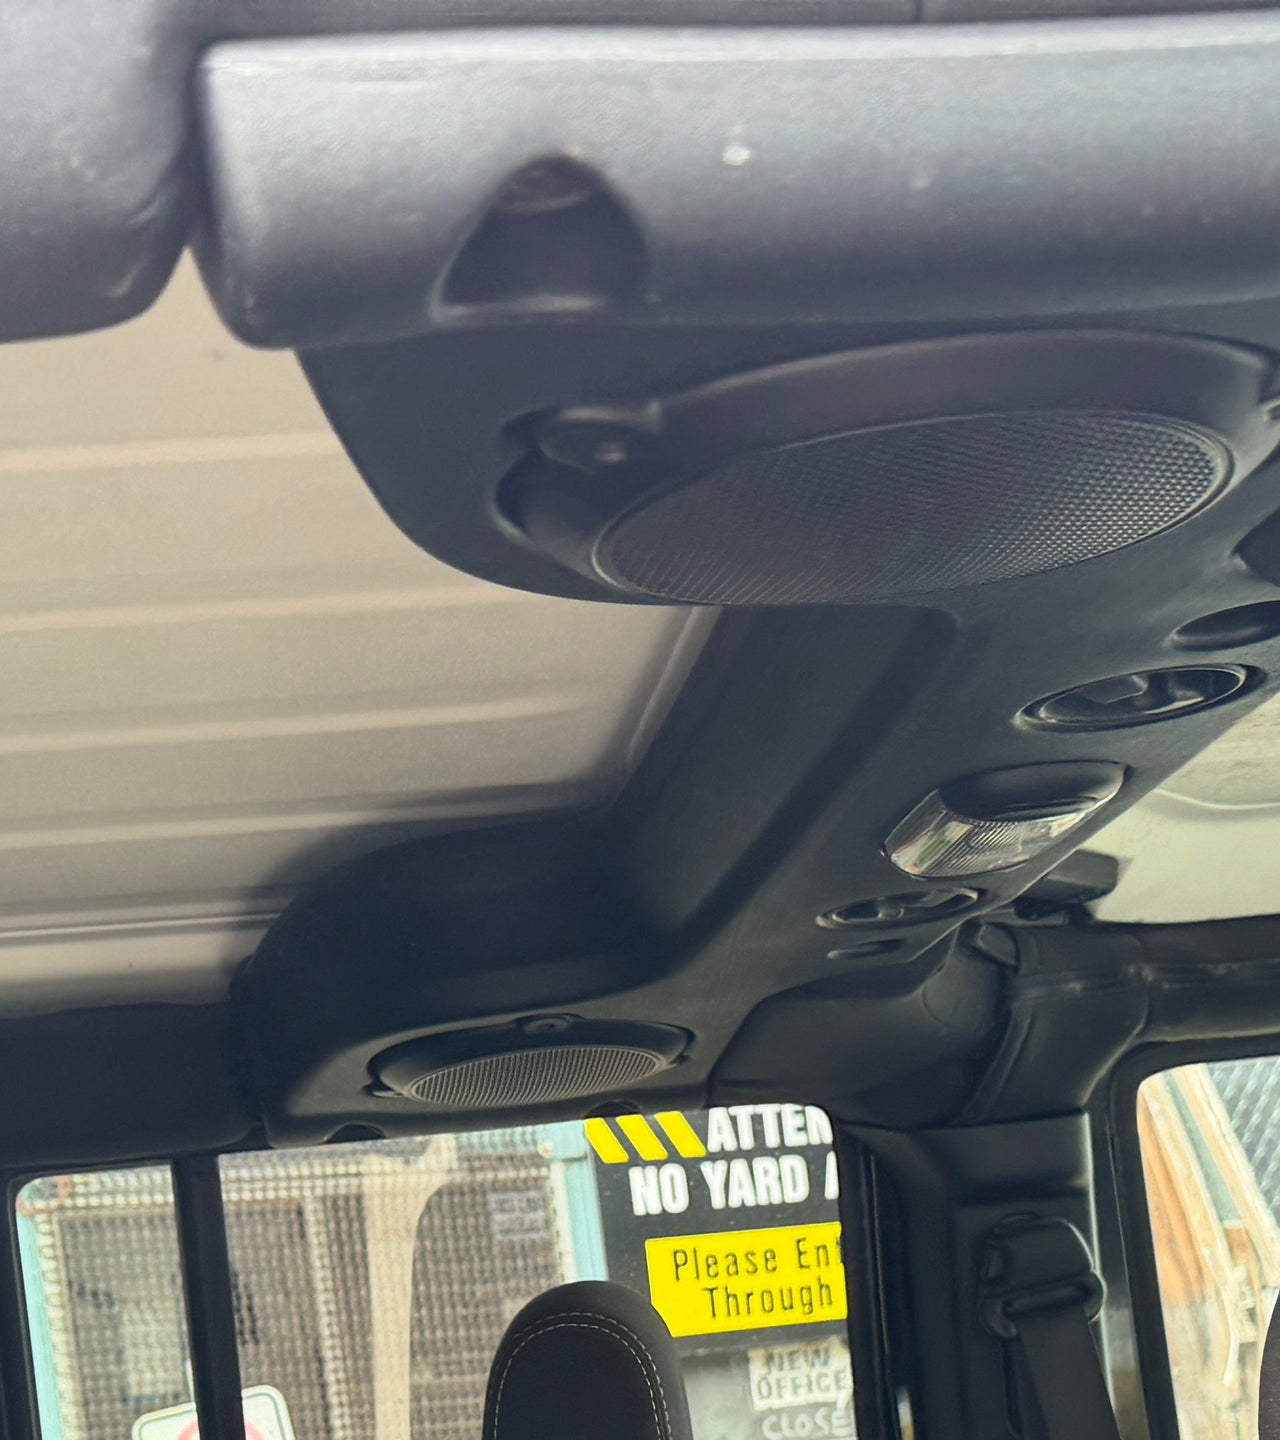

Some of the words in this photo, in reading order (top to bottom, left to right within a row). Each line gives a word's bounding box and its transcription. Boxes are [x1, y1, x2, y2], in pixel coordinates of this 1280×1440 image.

[628, 1162, 691, 1216] NO
[700, 1154, 810, 1209] YARD
[672, 1246, 778, 1282] Please
[795, 1236, 842, 1269] En
[703, 1276, 833, 1319] Through
[761, 1345, 831, 1373] NEW
